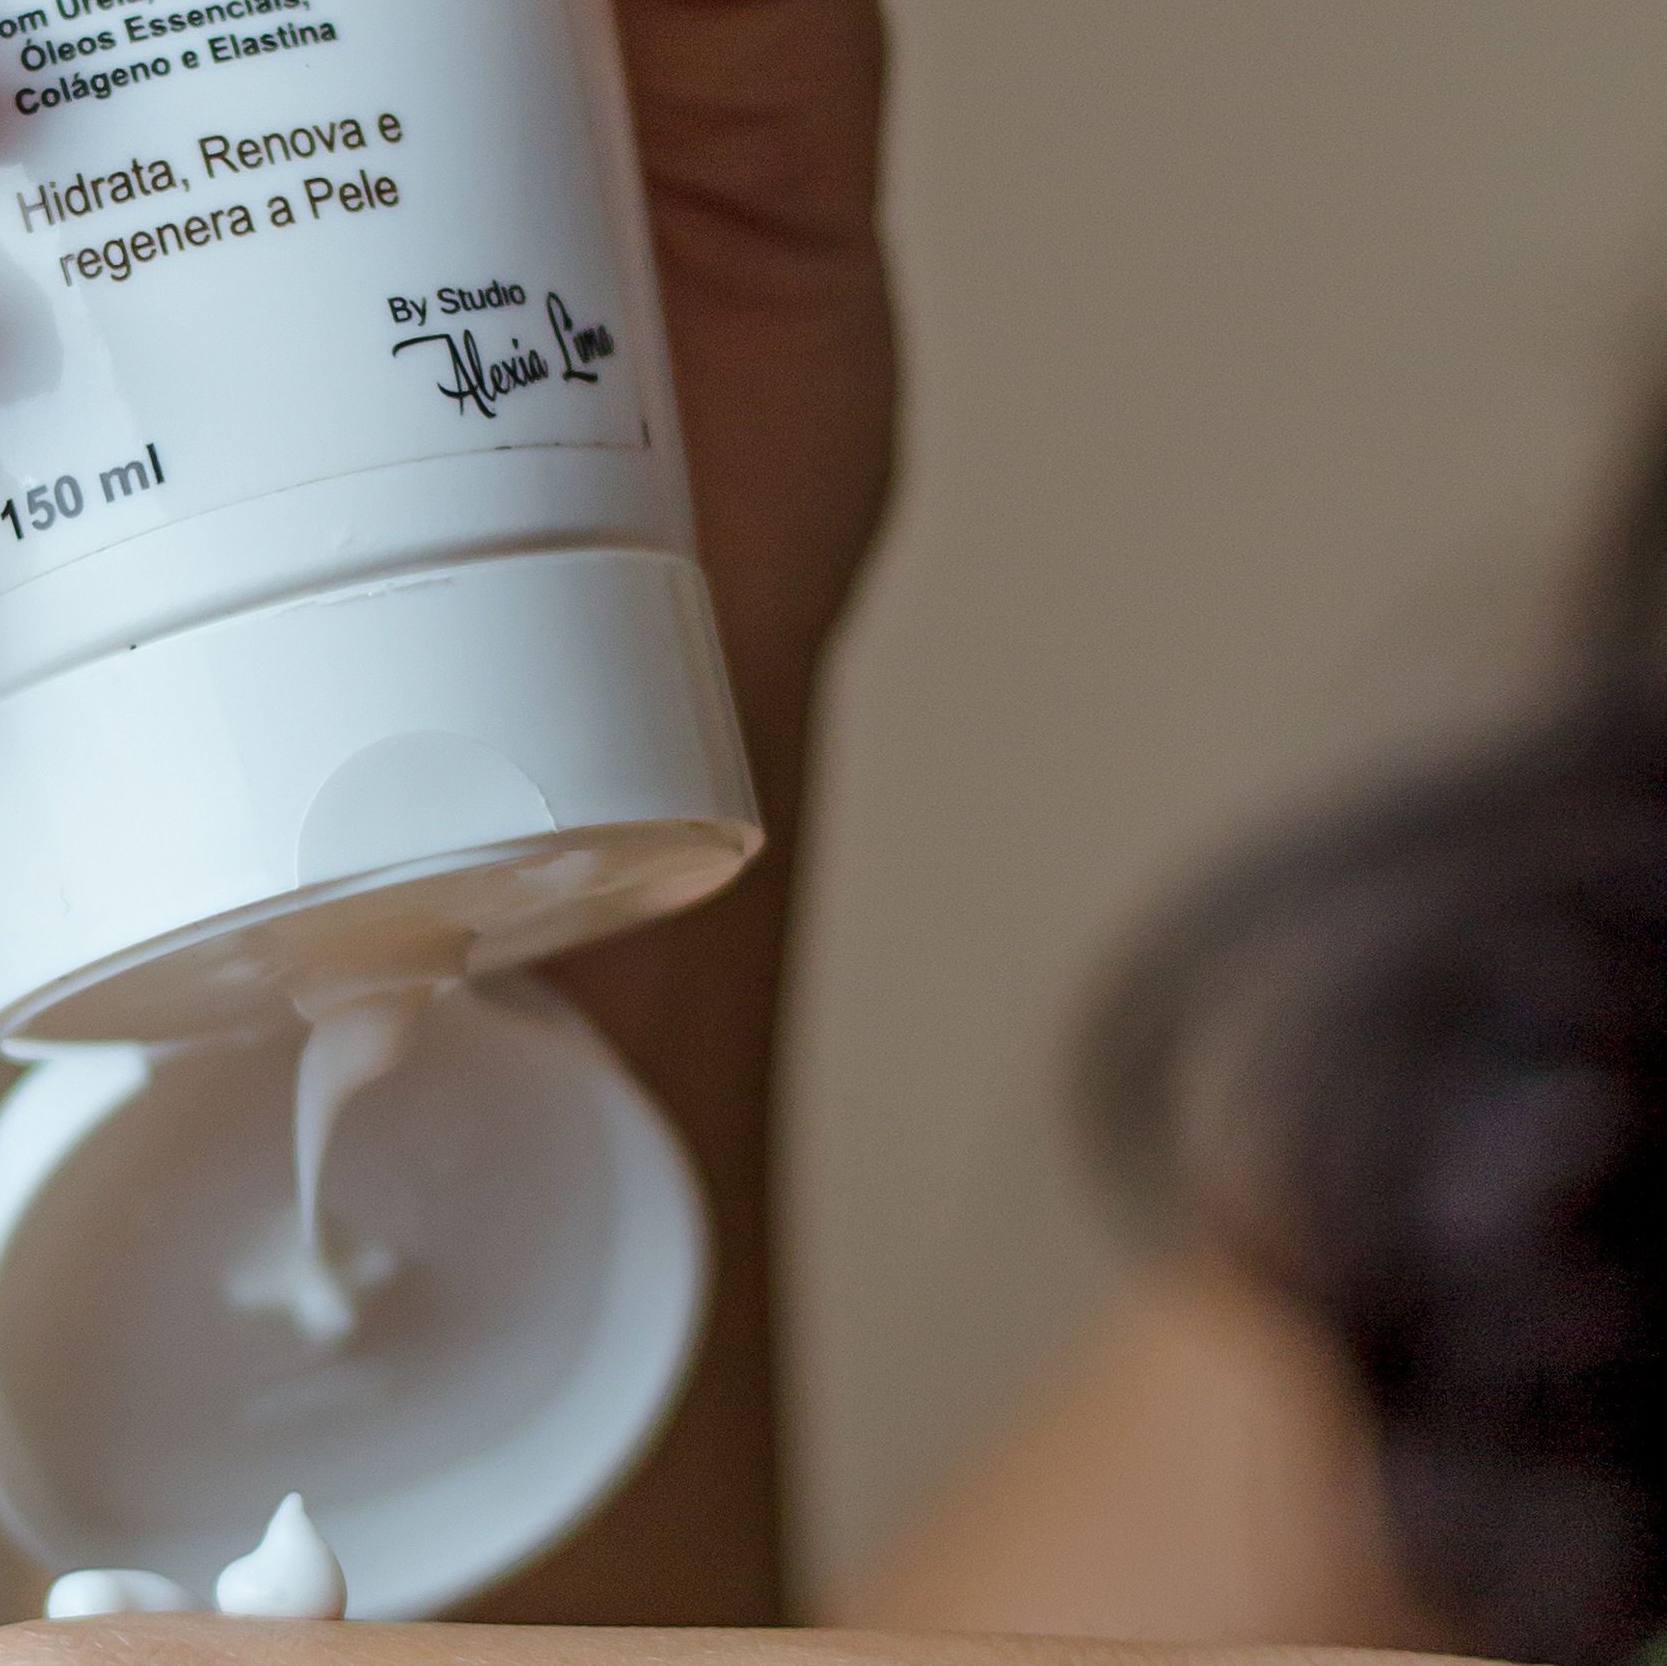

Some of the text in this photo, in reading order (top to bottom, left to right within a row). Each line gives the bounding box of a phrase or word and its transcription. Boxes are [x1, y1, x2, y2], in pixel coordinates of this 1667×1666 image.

[15, 21, 338, 115] Colágeno e Elastina
[20, 29, 116, 71] Óleos
[16, 112, 404, 233] Hidrata, Renova e
[59, 169, 401, 286] regenera a Pele
[387, 280, 526, 326] By Studio
[0, 443, 165, 541] 150 ml
